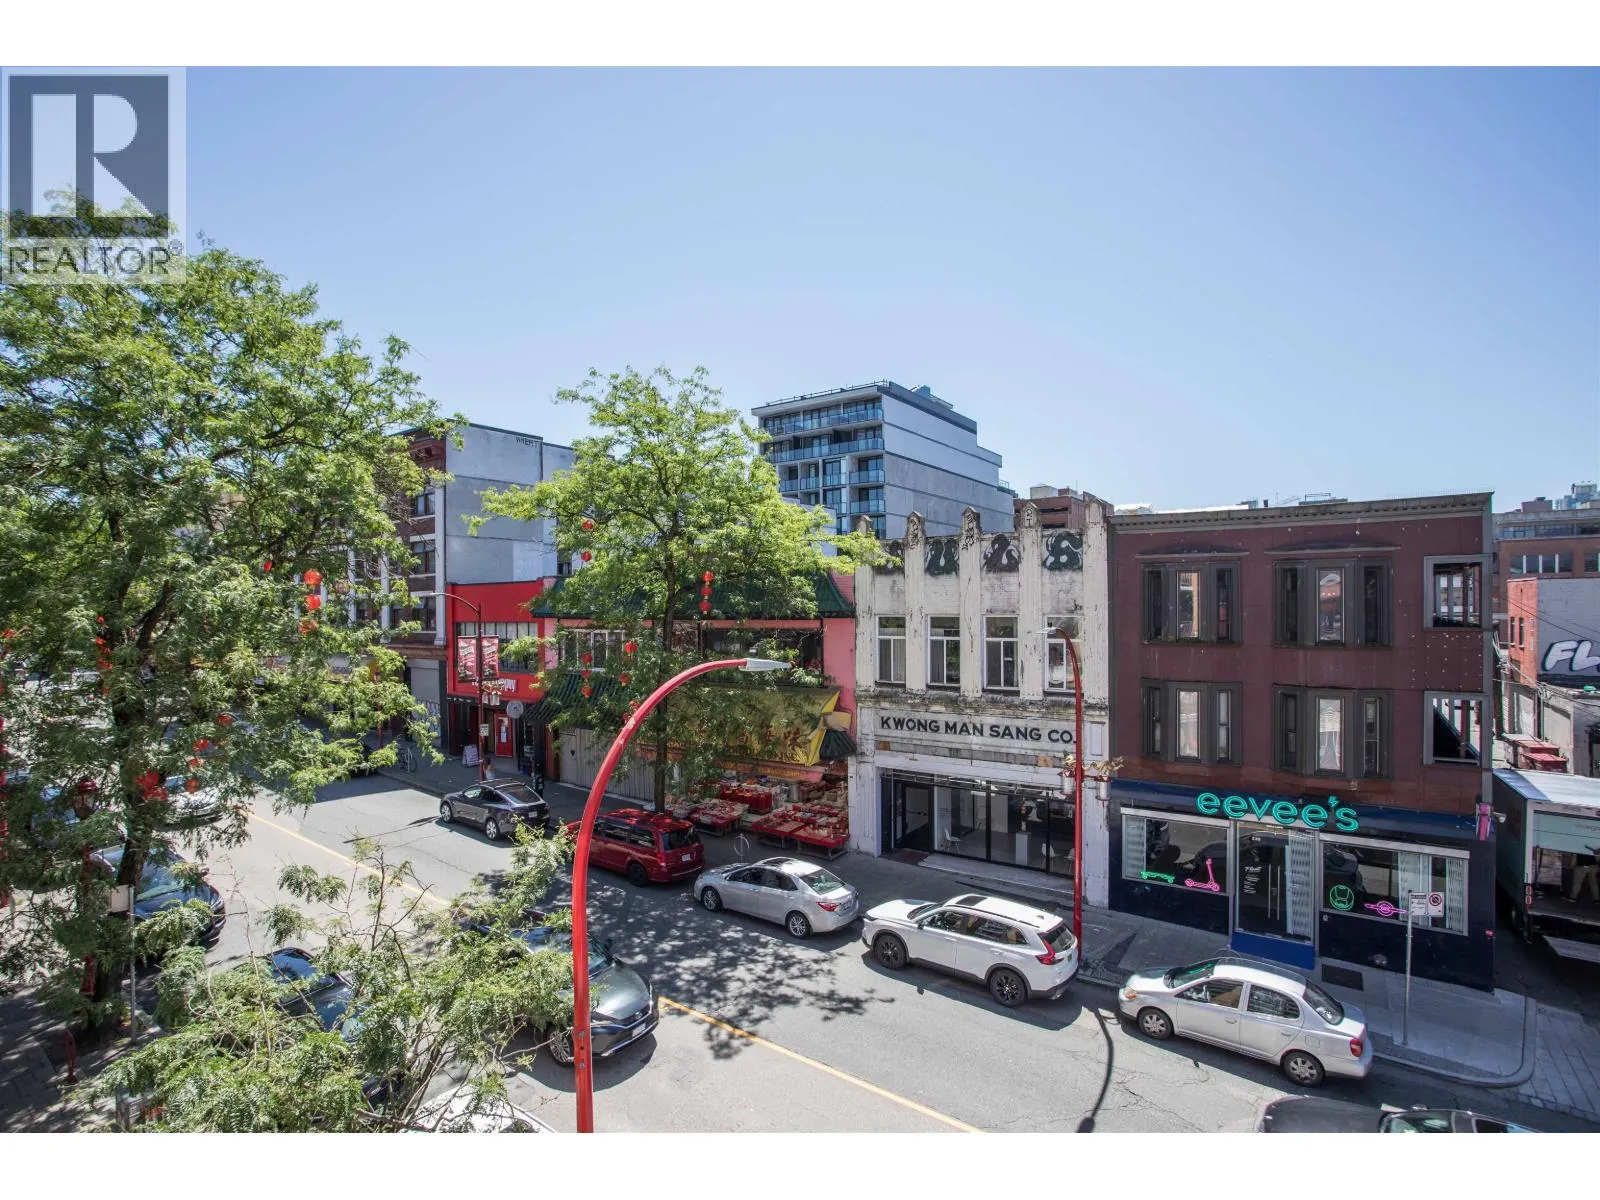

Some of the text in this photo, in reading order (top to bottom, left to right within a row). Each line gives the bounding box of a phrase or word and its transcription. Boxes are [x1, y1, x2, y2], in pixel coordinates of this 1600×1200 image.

[1541, 639, 1600, 672] FL
[880, 716, 940, 733] KWONG
[944, 721, 984, 737] MAN
[989, 724, 1042, 741] SANG
[1197, 792, 1359, 832] eevee's
